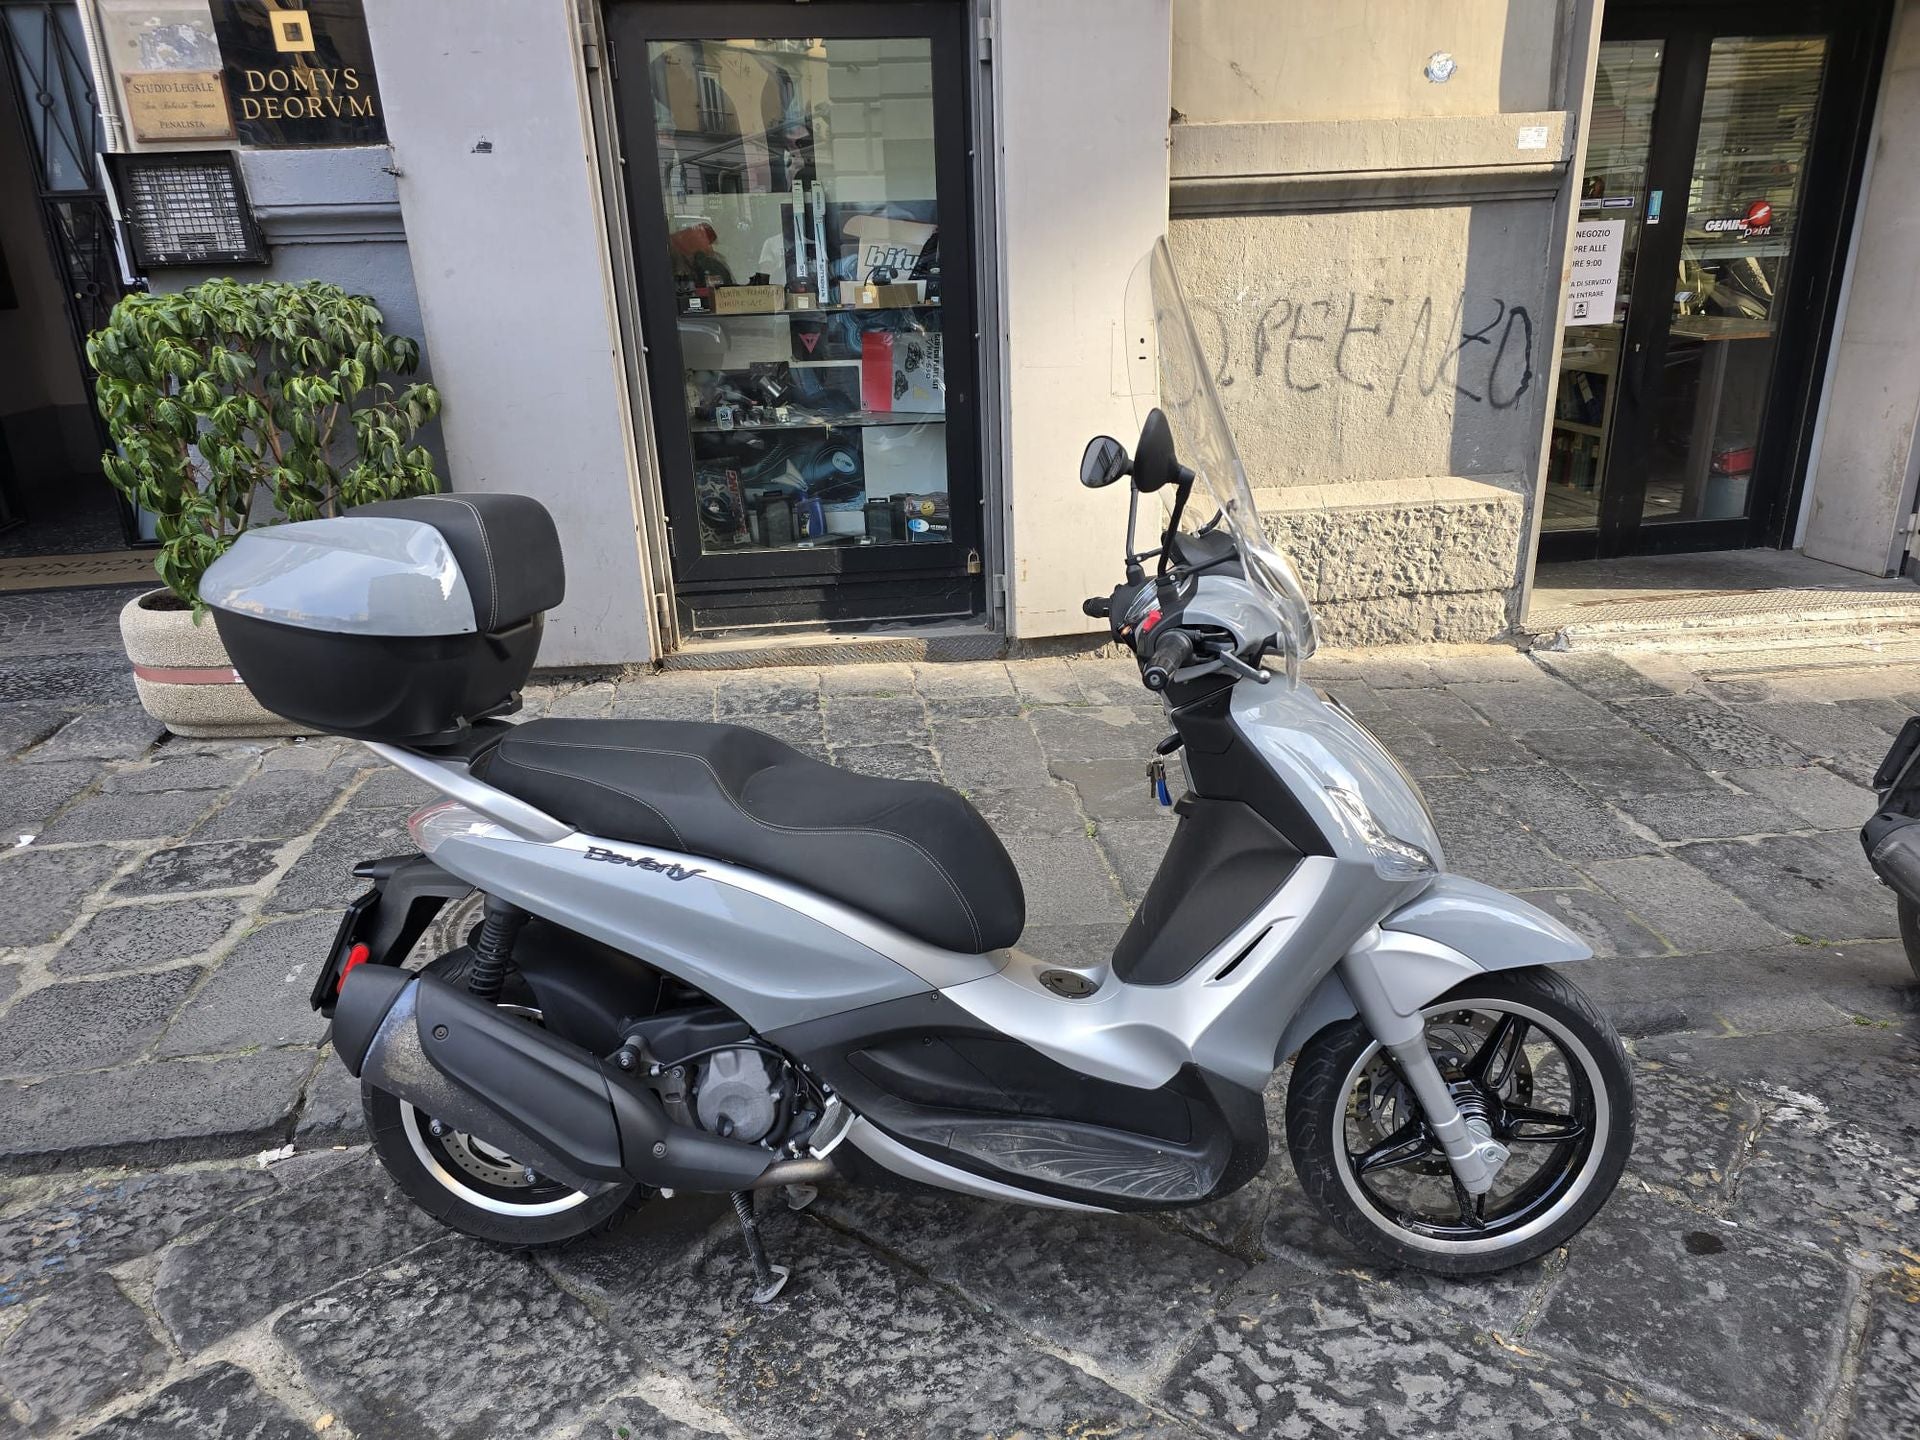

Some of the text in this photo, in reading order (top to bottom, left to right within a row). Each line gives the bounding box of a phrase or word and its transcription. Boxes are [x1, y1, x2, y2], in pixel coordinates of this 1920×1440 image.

[244, 68, 359, 92] DOMVS
[133, 82, 215, 94] STUDIO LEGALE
[240, 95, 376, 119] DEORVM
[160, 121, 206, 129] PENALISTA
[1575, 230, 1611, 238] NEGOZIO
[1574, 244, 1607, 253] PRE ALLE
[1576, 291, 1605, 299] ENTRARE
[583, 846, 707, 882] Beverly
